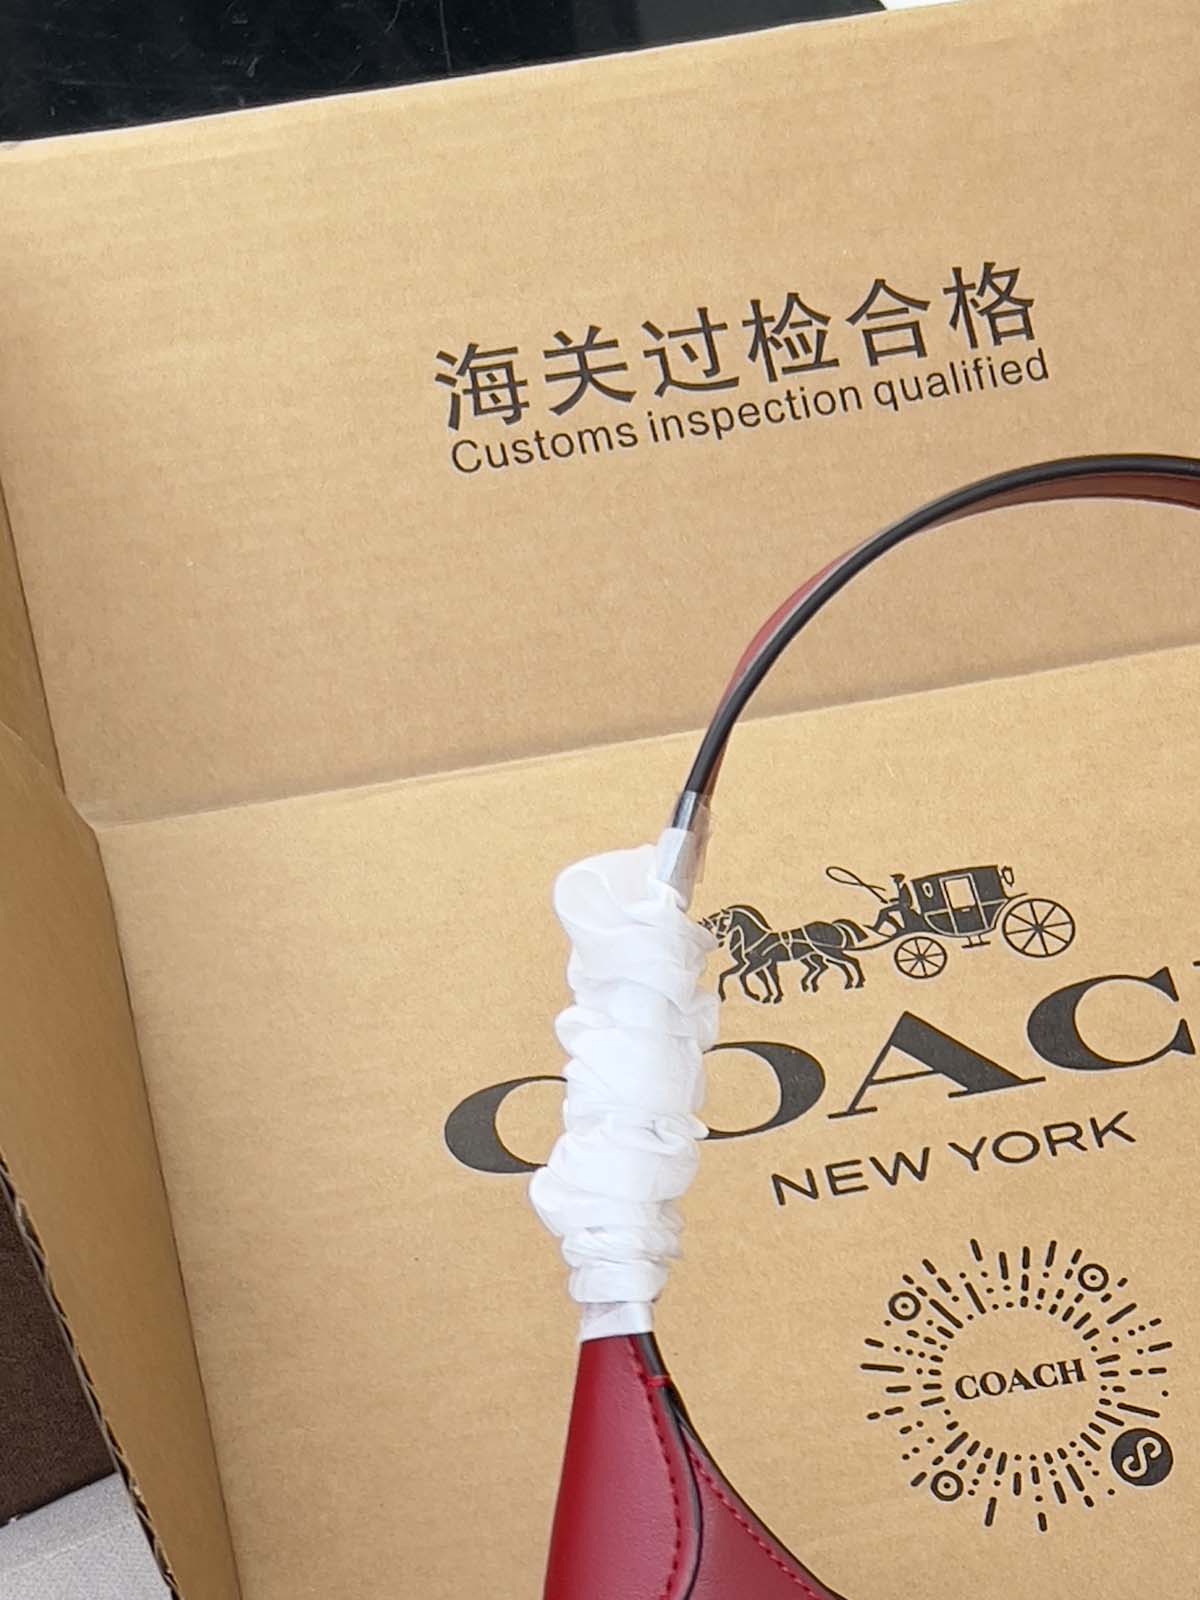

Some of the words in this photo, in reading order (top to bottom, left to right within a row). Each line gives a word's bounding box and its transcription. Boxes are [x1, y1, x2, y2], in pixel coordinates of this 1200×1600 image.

[434, 261, 1035, 431] 海关过检合格
[451, 422, 638, 473] Customs
[648, 387, 863, 442] inspection
[873, 348, 1049, 412] qualified
[771, 1149, 929, 1206] NEW
[948, 1110, 1137, 1172] YORK
[955, 1358, 1087, 1400] COACH
